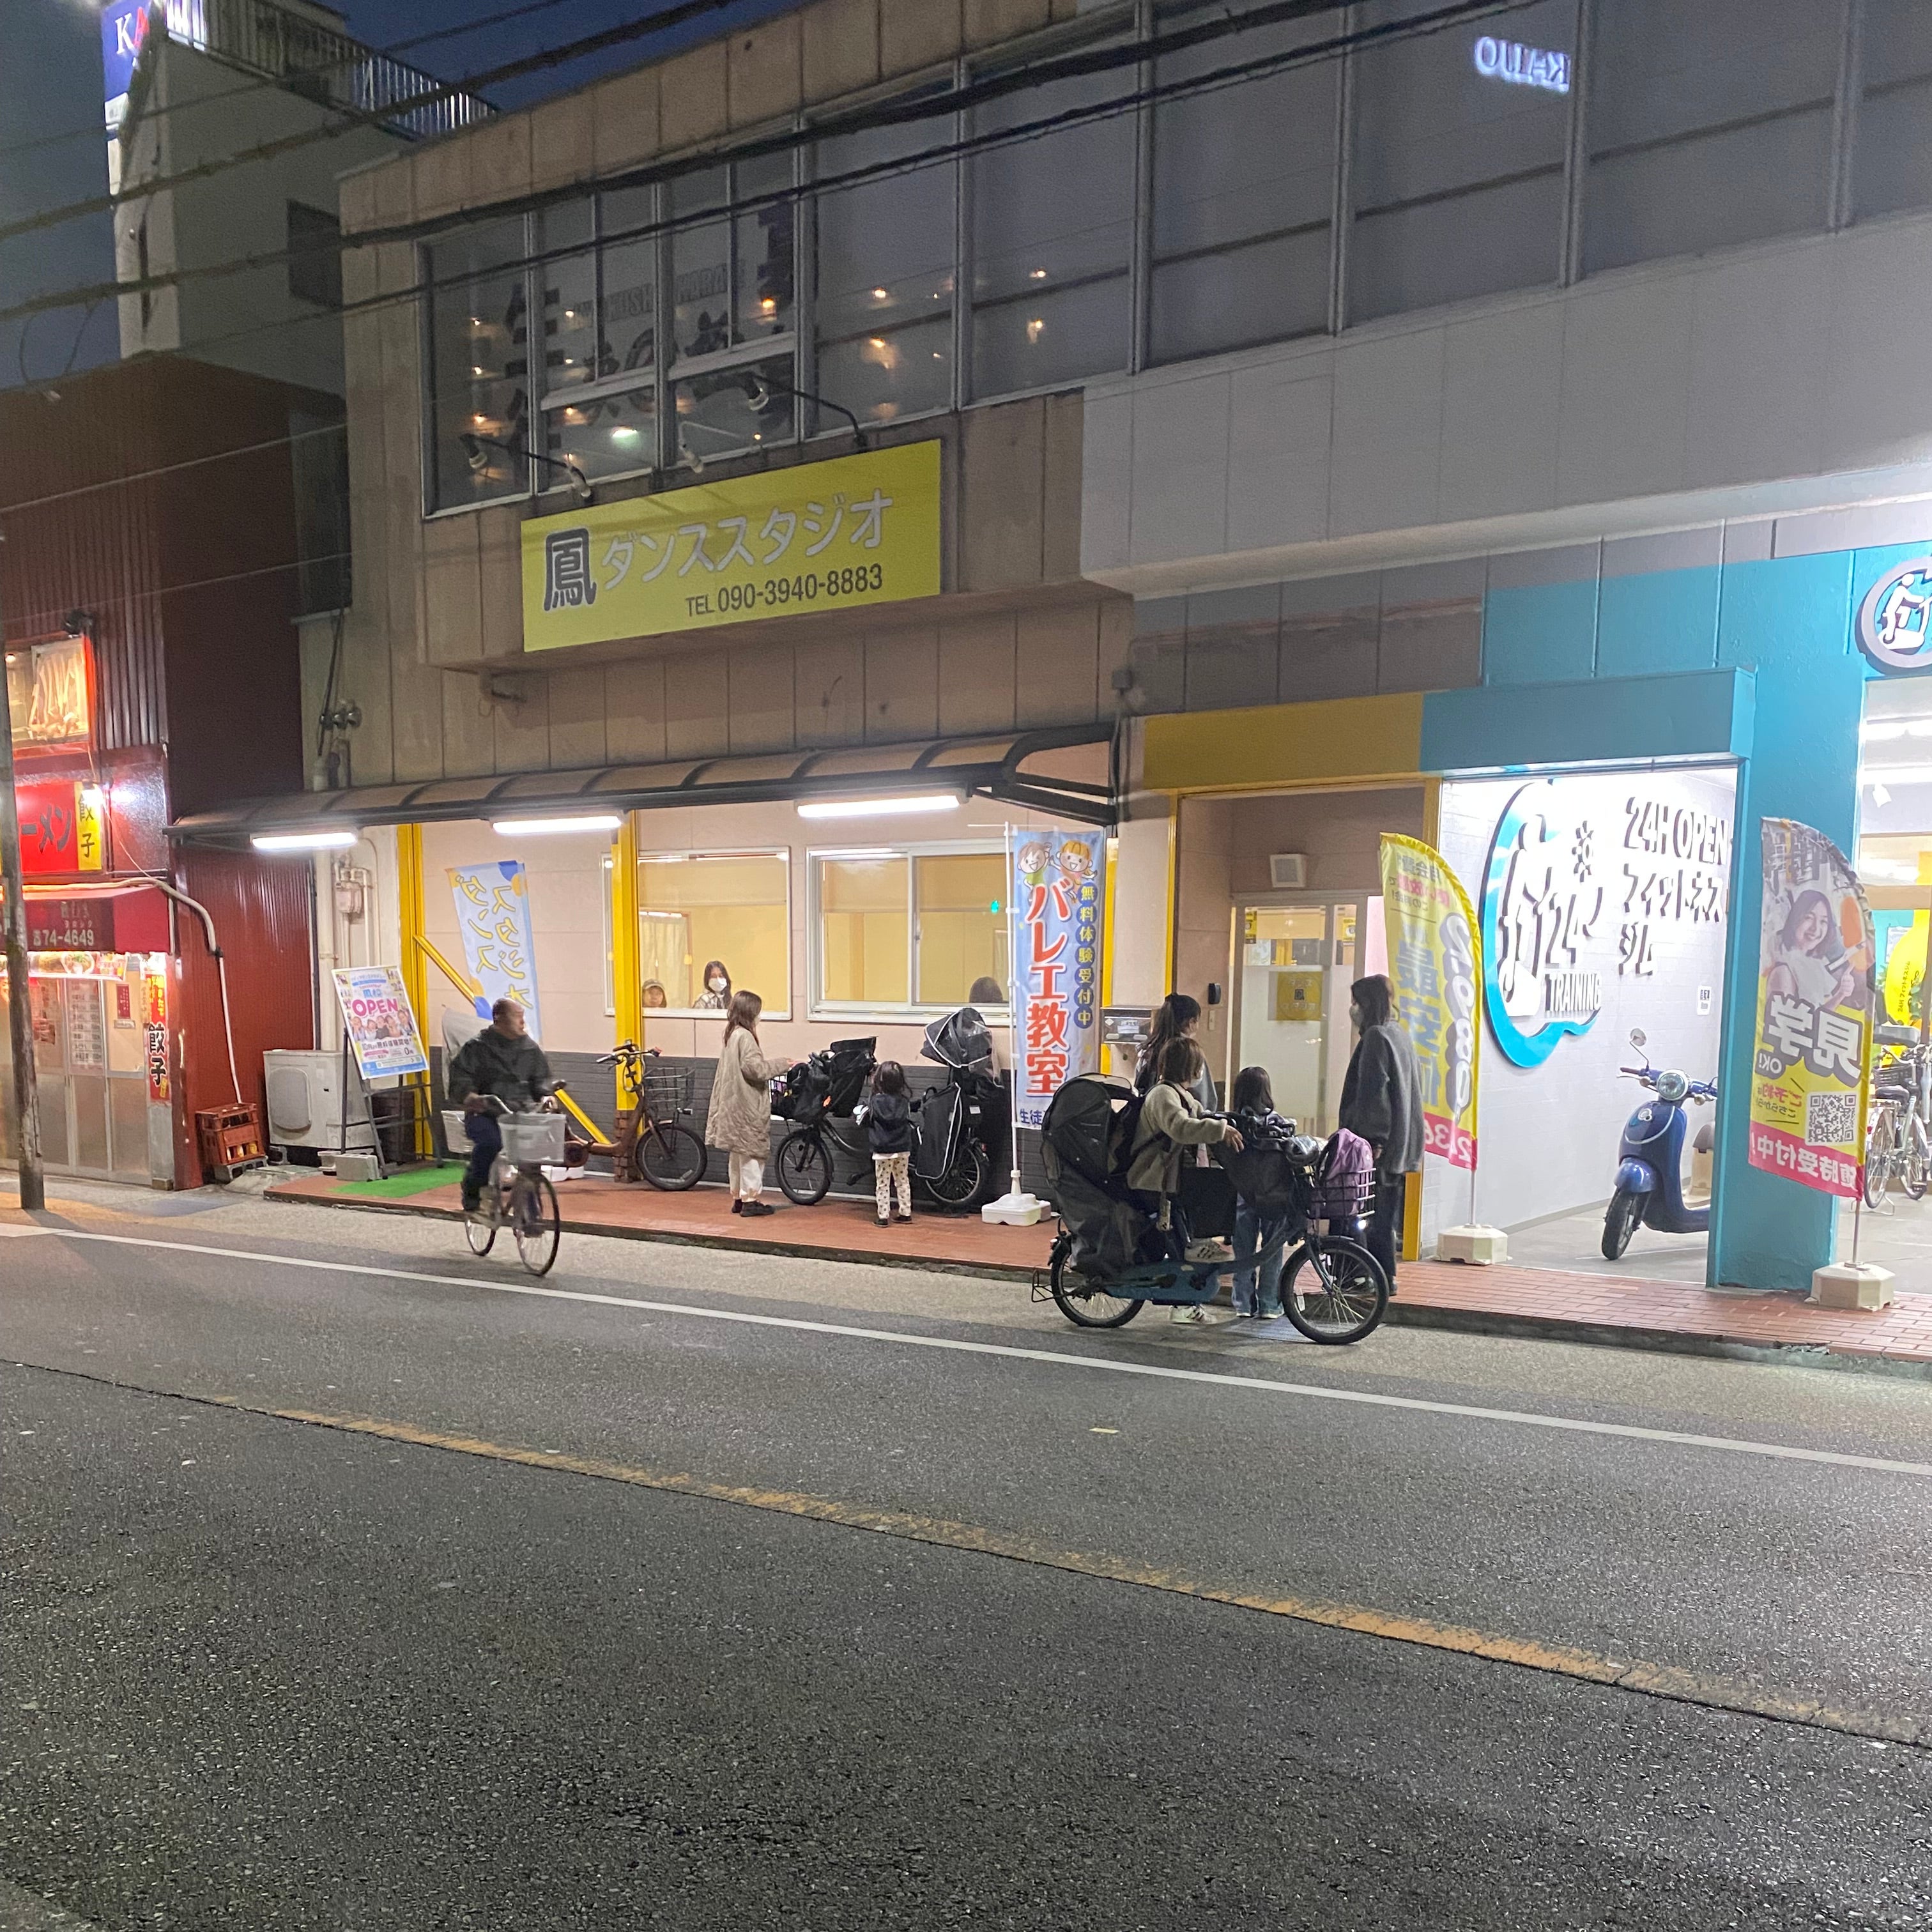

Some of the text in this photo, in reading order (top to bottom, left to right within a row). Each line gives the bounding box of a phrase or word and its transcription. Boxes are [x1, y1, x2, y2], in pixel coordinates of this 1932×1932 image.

[686, 563, 884, 618] TEL 090-3940-8883
[21, 804, 72, 855] ーメン
[1672, 808, 1729, 865] OPEN
[1077, 883, 1097, 1027] 無料体験受付中
[352, 999, 399, 1016] OPEN
[1025, 877, 1072, 1095] バレエ教室
[1545, 972, 1602, 1012] TRAINING
[148, 1022, 167, 1086] 餃子
[1020, 1108, 1046, 1126] 生徒
